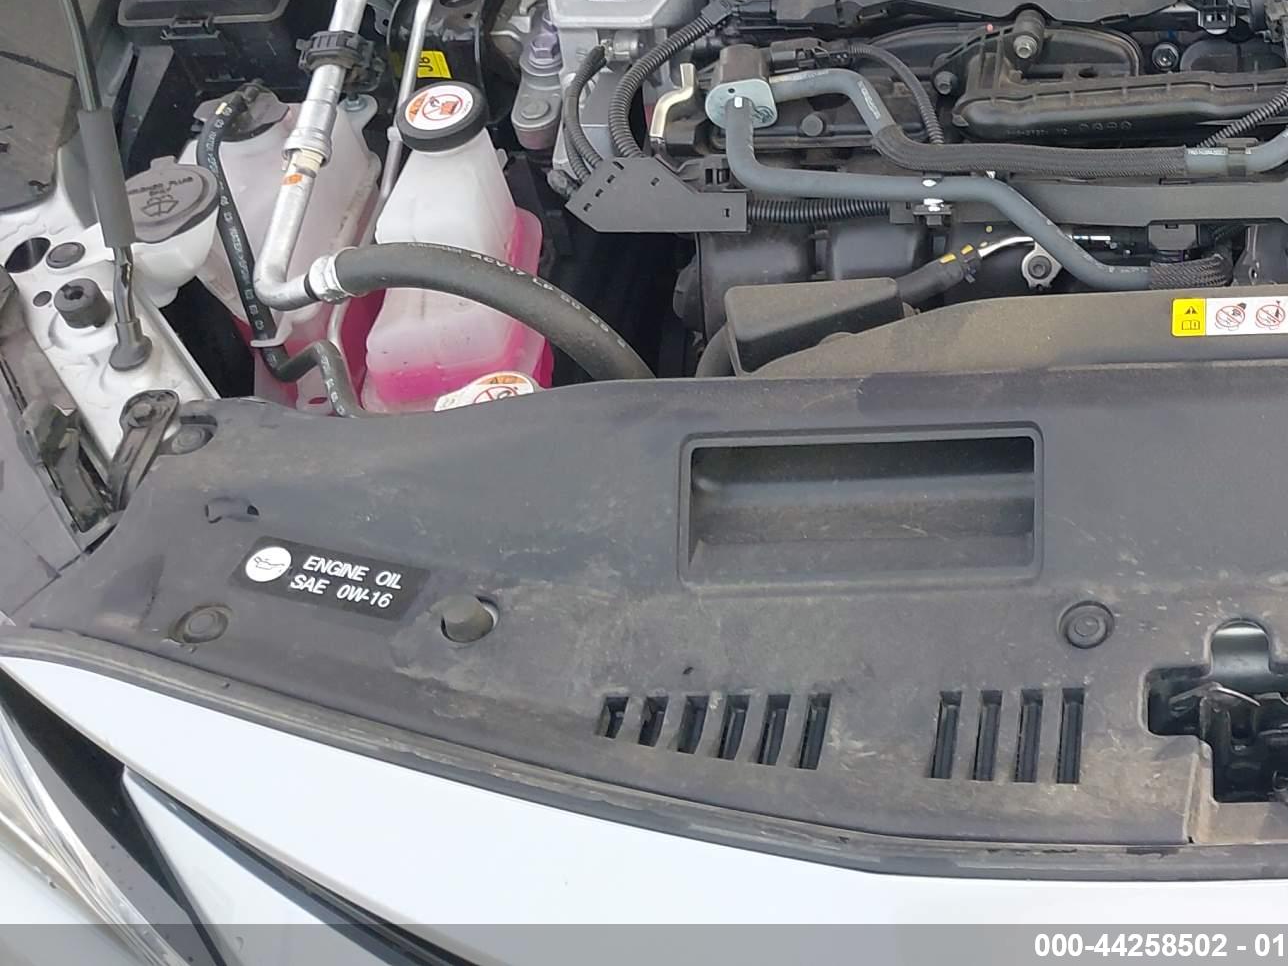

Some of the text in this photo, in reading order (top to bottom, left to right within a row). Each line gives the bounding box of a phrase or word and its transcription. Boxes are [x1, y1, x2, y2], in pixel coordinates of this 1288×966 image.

[303, 555, 402, 590] ENGINE OIL
[290, 574, 393, 609] SAE 0W-16
